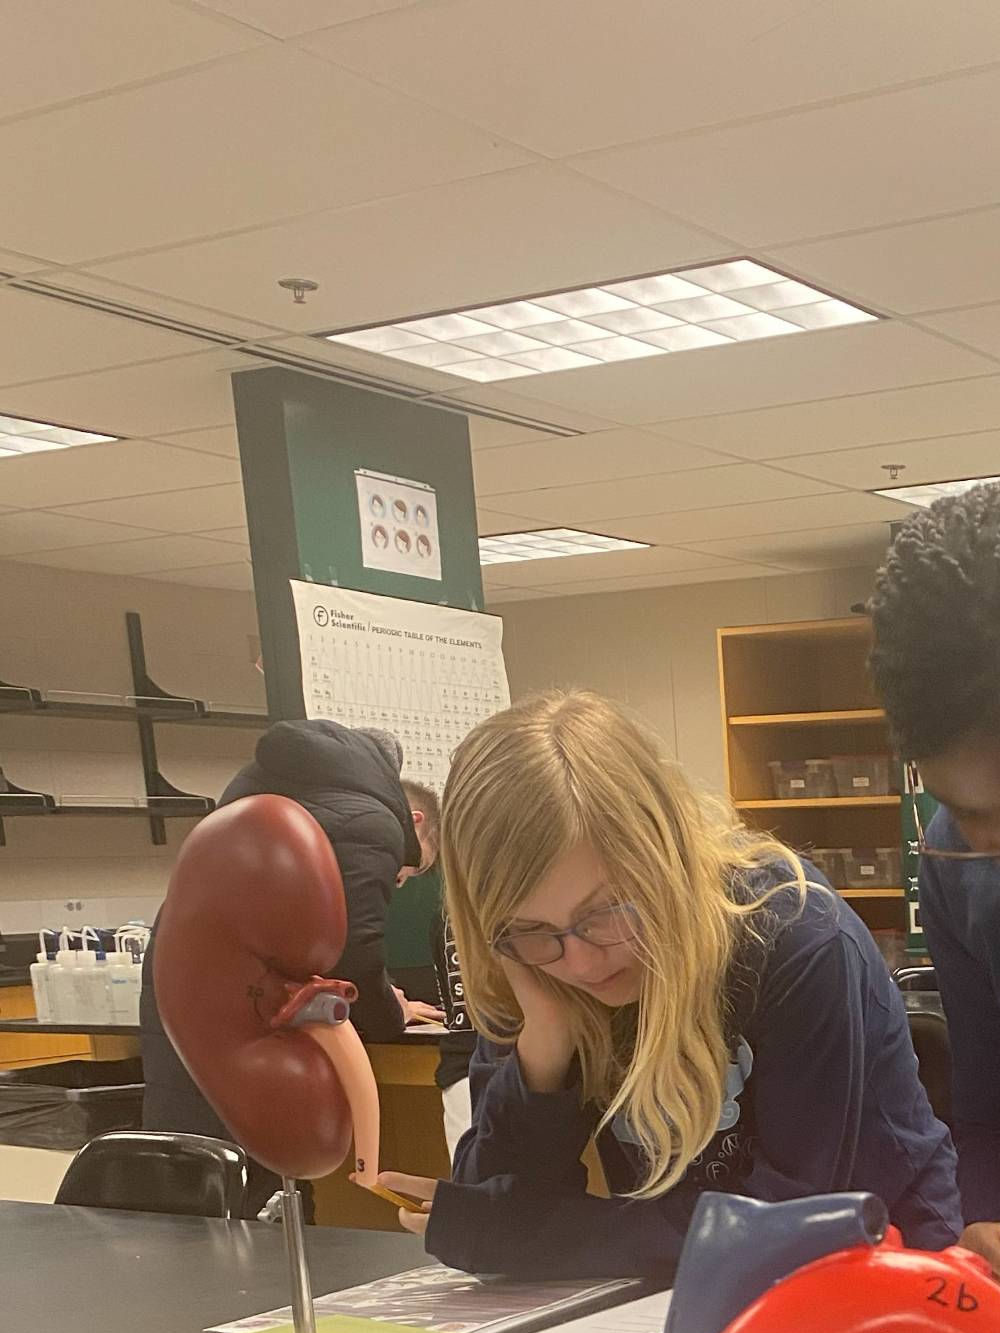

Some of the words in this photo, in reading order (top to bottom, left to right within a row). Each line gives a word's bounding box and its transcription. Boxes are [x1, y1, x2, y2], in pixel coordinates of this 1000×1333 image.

[330, 609, 354, 621] Fisher
[331, 619, 367, 632] Scientific
[371, 625, 403, 638] PERIODIC
[404, 631, 424, 641] TABLE
[425, 634, 435, 642] OF
[435, 636, 448, 644] THE
[449, 637, 483, 649] ELEMENTS
[926, 1276, 978, 1313] 2b
